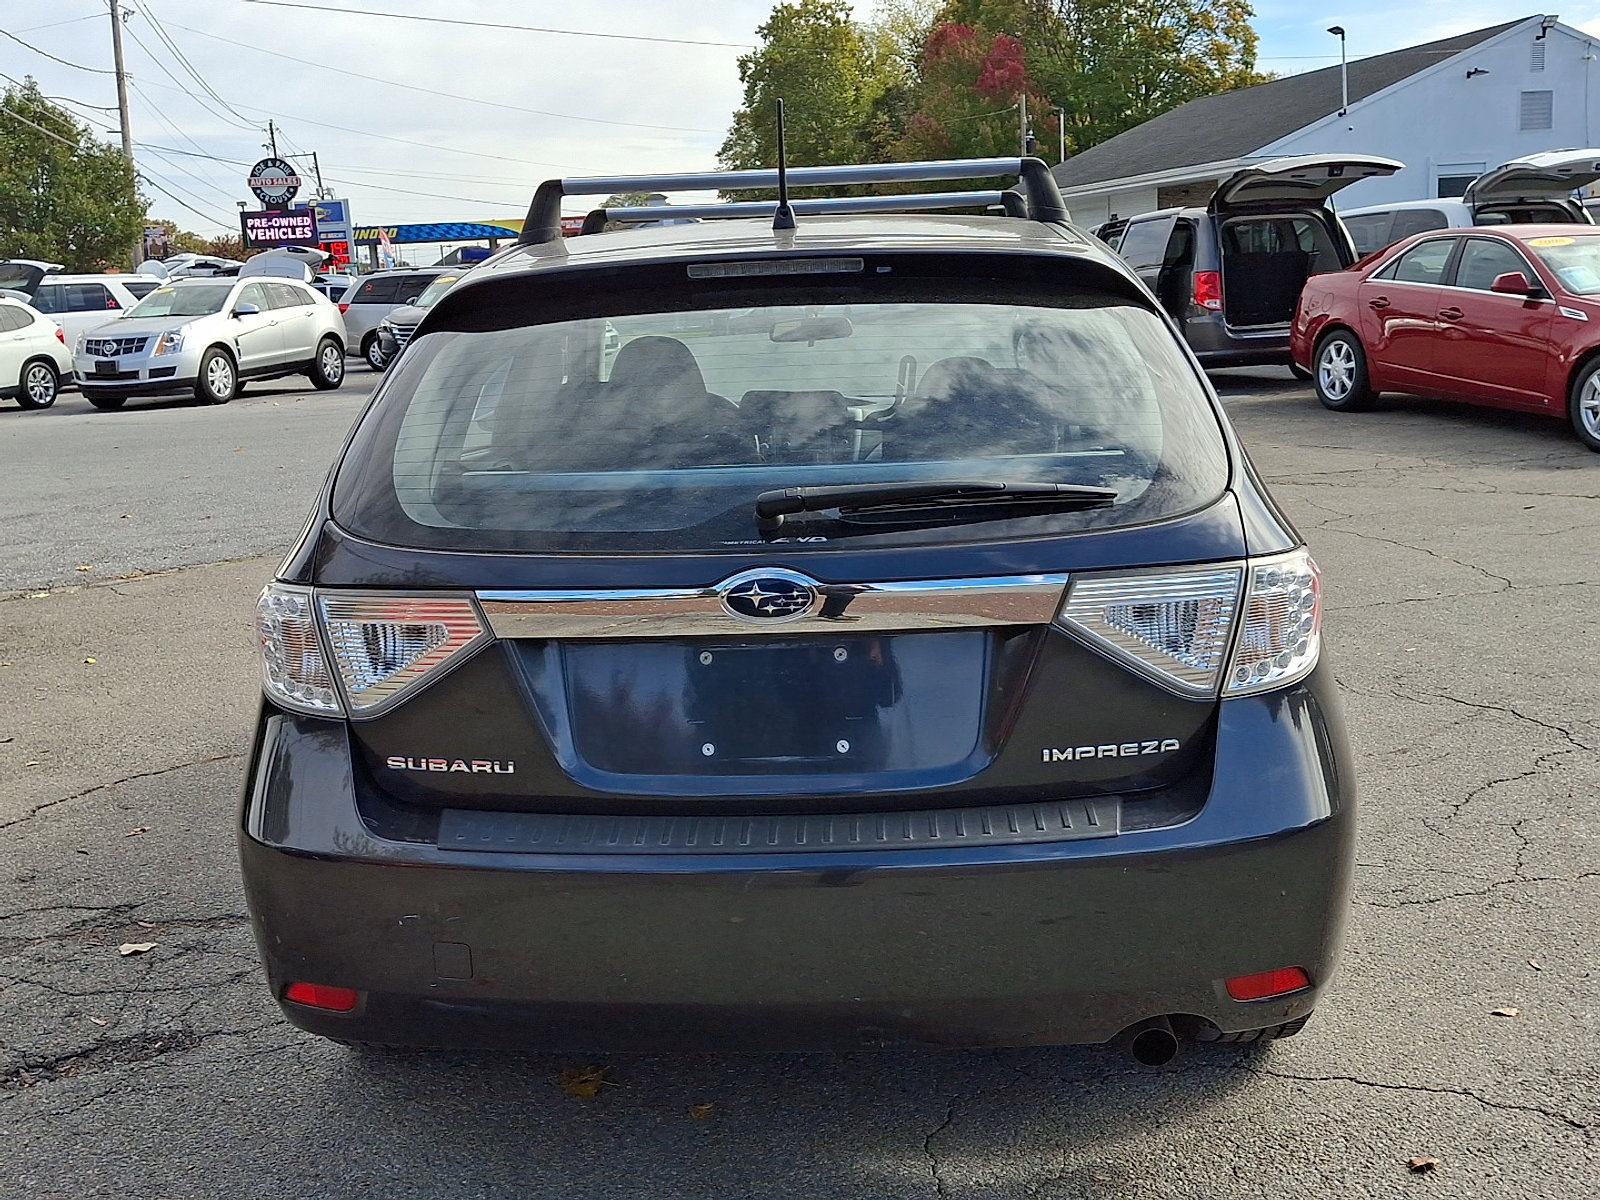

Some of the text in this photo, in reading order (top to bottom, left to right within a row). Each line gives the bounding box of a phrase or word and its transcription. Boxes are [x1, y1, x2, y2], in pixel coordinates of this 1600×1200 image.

[253, 162, 267, 176] JOE
[275, 160, 291, 175] PAUL
[250, 177, 298, 186] AUTO SALES
[259, 191, 293, 204] CROUSE
[247, 216, 311, 228] PRE-OWNED
[246, 227, 312, 240] VEHICLES
[1042, 738, 1180, 762] IMPREZA
[386, 756, 515, 774] SUBARU
